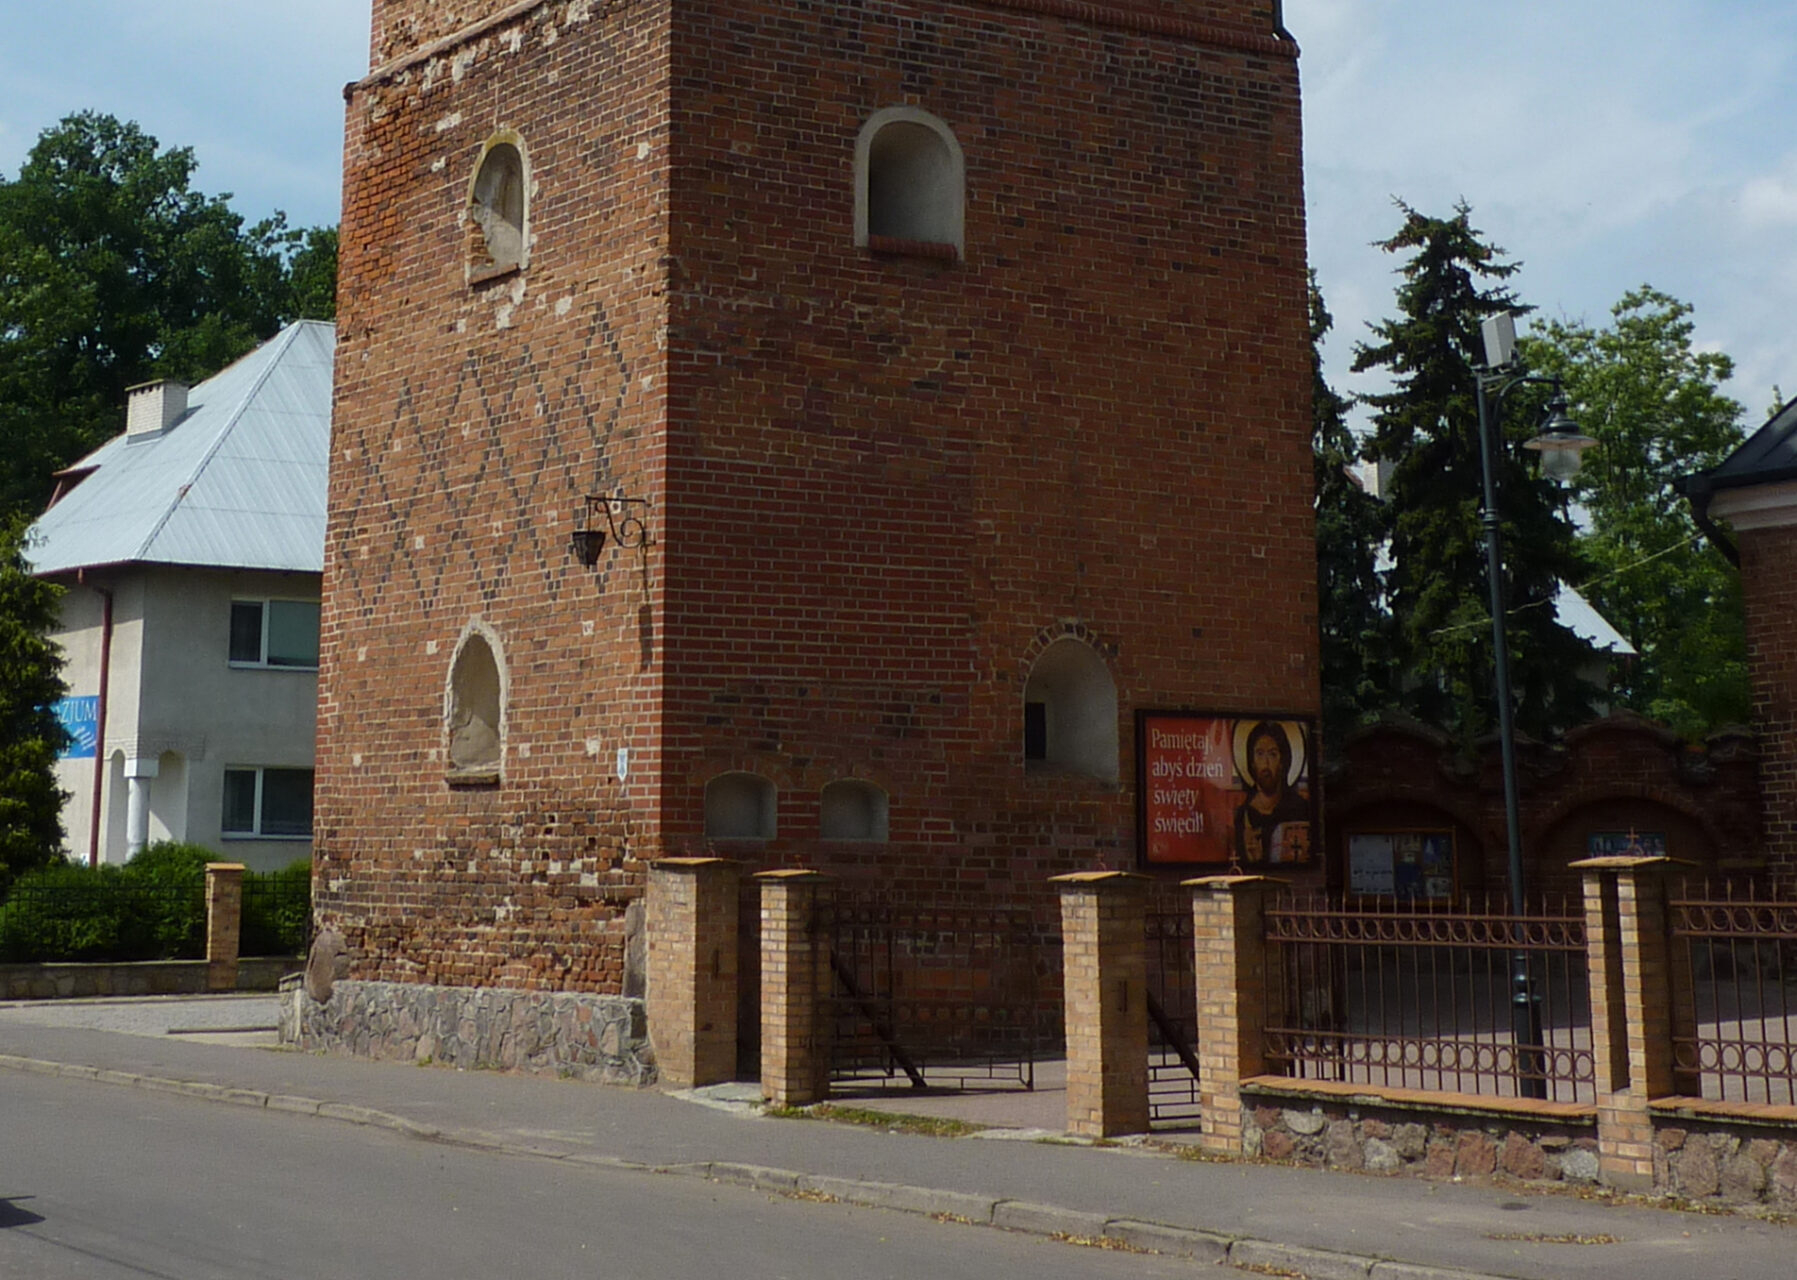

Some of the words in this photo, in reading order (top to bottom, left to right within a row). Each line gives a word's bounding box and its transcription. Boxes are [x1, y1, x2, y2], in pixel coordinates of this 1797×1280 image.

[1151, 728, 1213, 754] Pamiętaj,
[1152, 756, 1183, 781] abyś
[1186, 757, 1223, 777] dzień
[1153, 783, 1199, 808] święty
